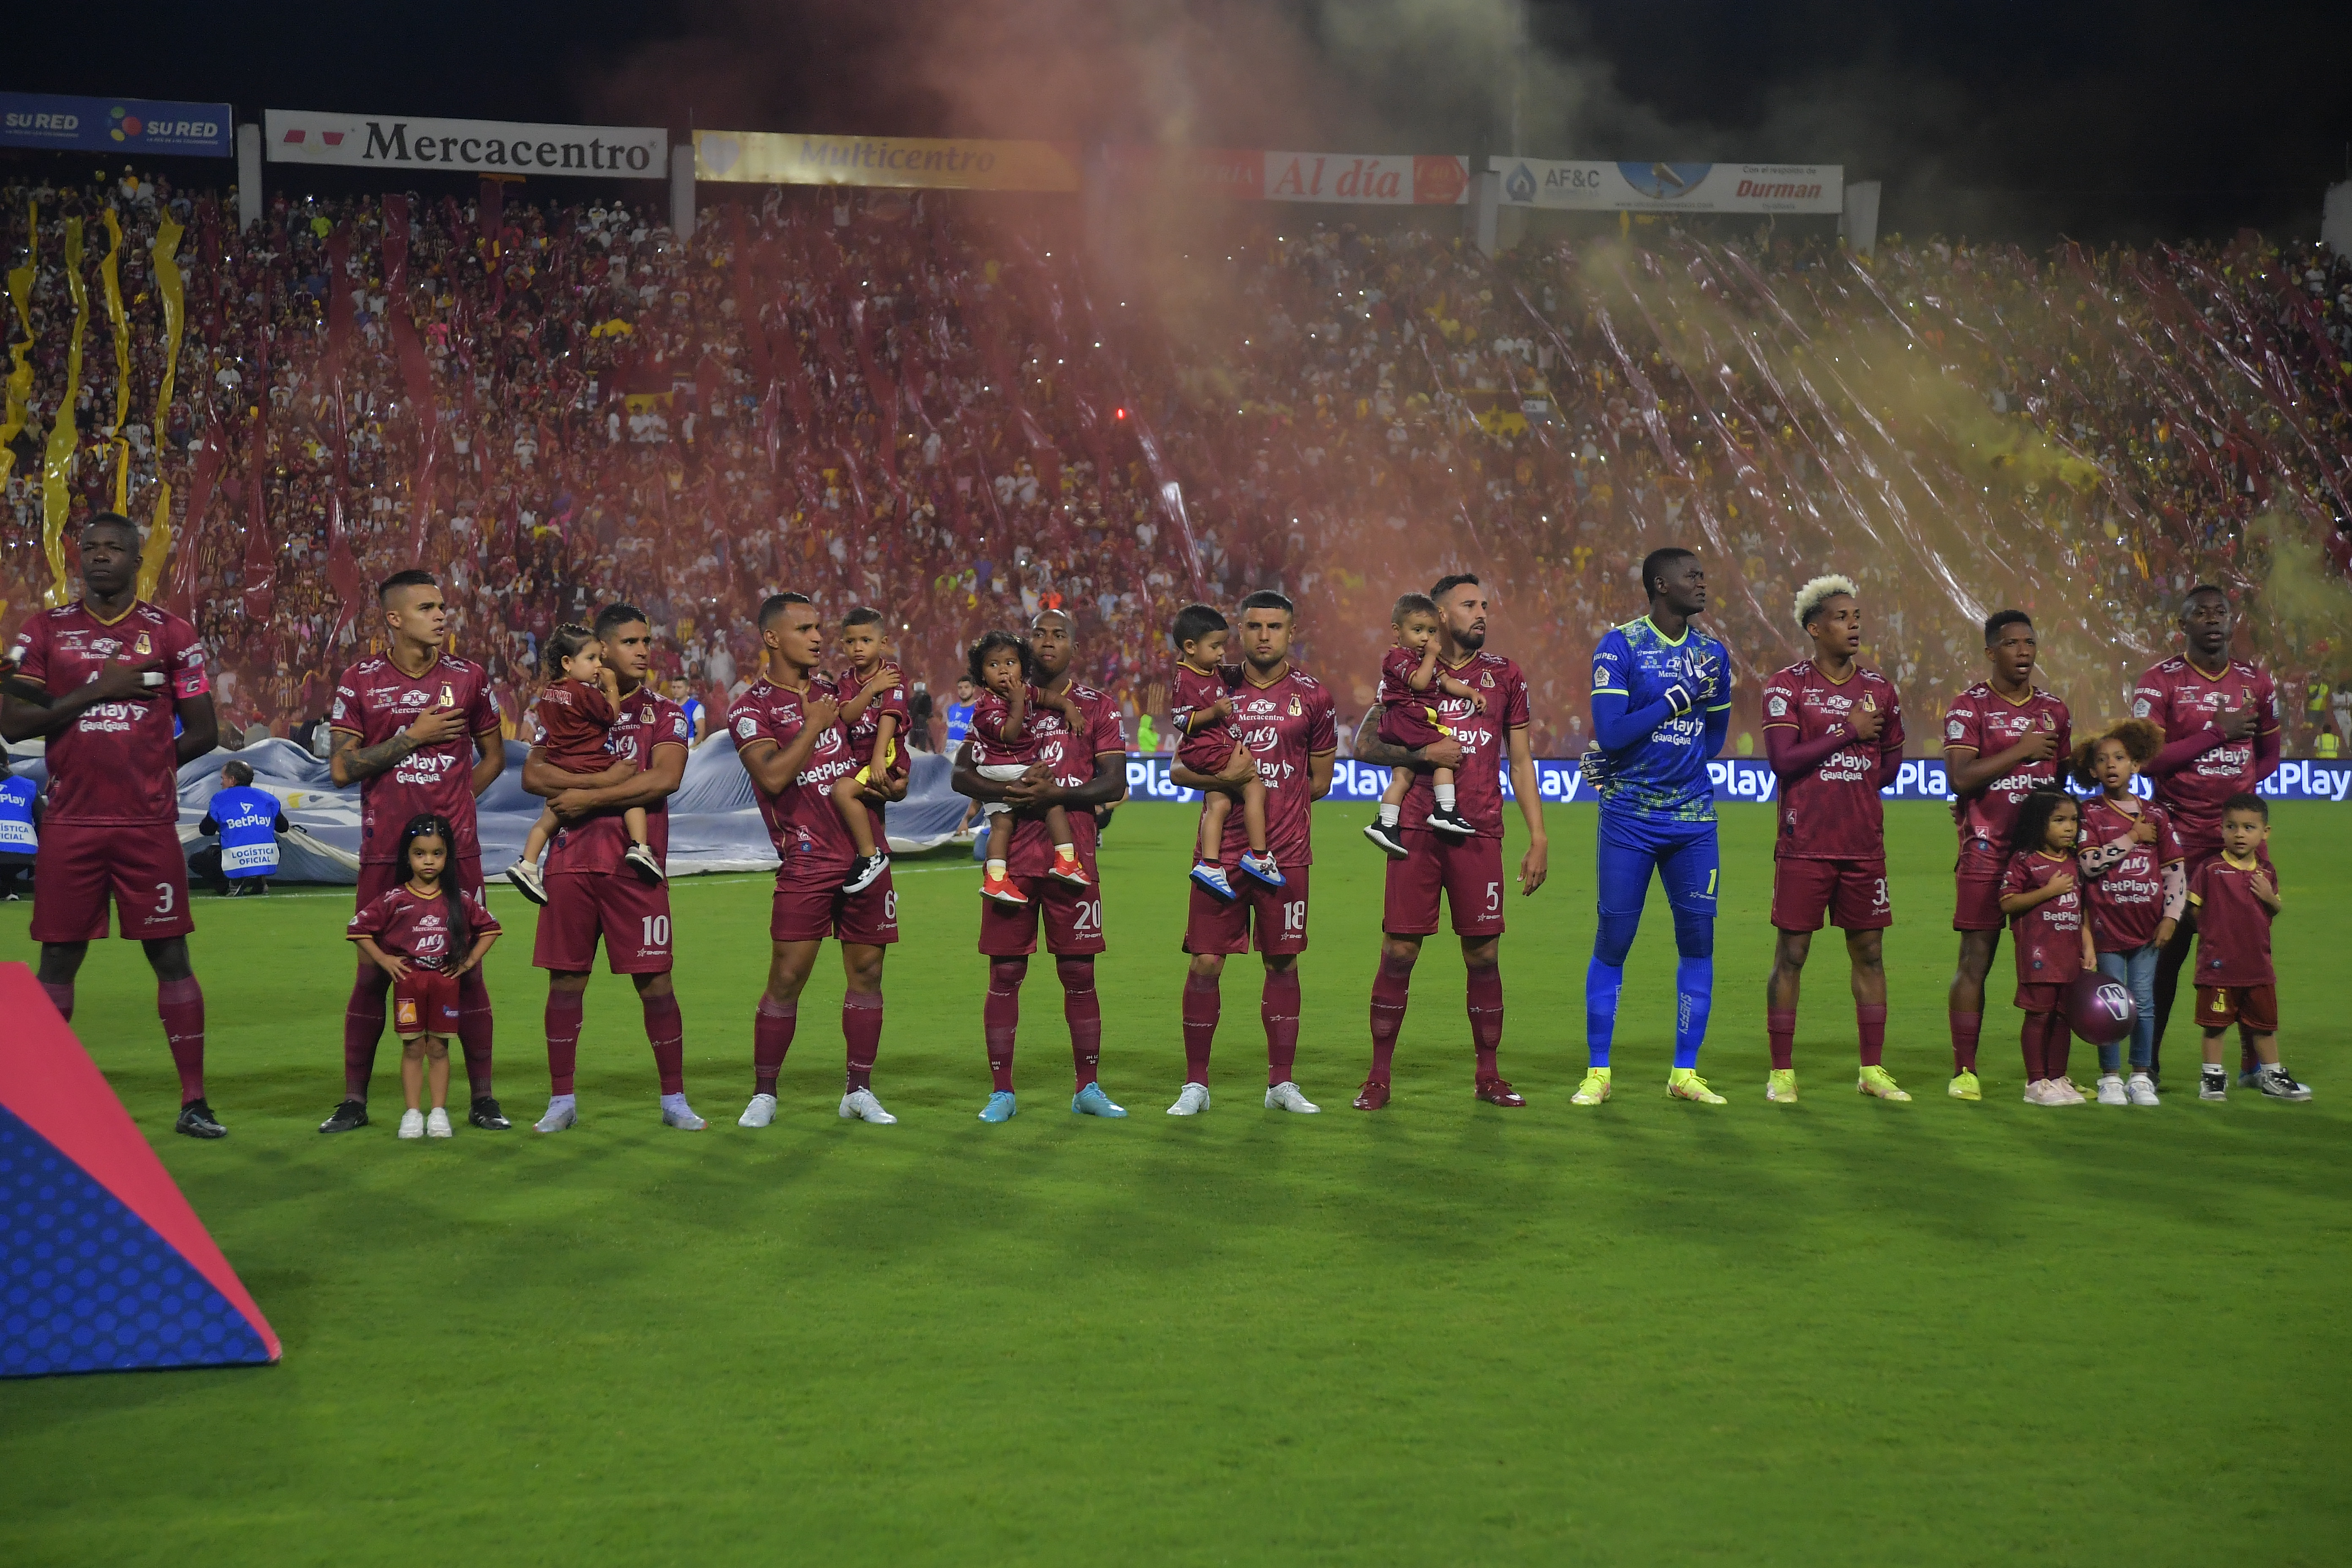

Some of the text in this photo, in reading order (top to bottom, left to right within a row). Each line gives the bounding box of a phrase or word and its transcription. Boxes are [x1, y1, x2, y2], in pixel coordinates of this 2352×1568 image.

[6, 113, 79, 131] SU RED
[147, 121, 218, 137] SU RED
[362, 122, 651, 170] Mercacentro
[799, 140, 995, 172] Multicentro
[1273, 157, 1326, 197] Al
[1336, 159, 1401, 199] día
[1545, 168, 1600, 188] AF&C
[1736, 180, 1822, 199] Durman
[186, 679, 200, 692] C
[226, 814, 271, 829] BetPlay
[232, 847, 274, 859] LOGÍSTICA
[239, 856, 271, 865] OFICIAL
[1706, 868, 1717, 895] 1
[1872, 878, 1889, 906] 3
[2102, 879, 2149, 892] BetPlay
[155, 882, 174, 913] 3
[884, 890, 896, 919] 6
[1486, 882, 1499, 911] 5
[1073, 899, 1101, 929] 20
[1283, 901, 1305, 930] 18
[642, 915, 669, 946] 10
[1679, 992, 1692, 1034] SHEFFY
